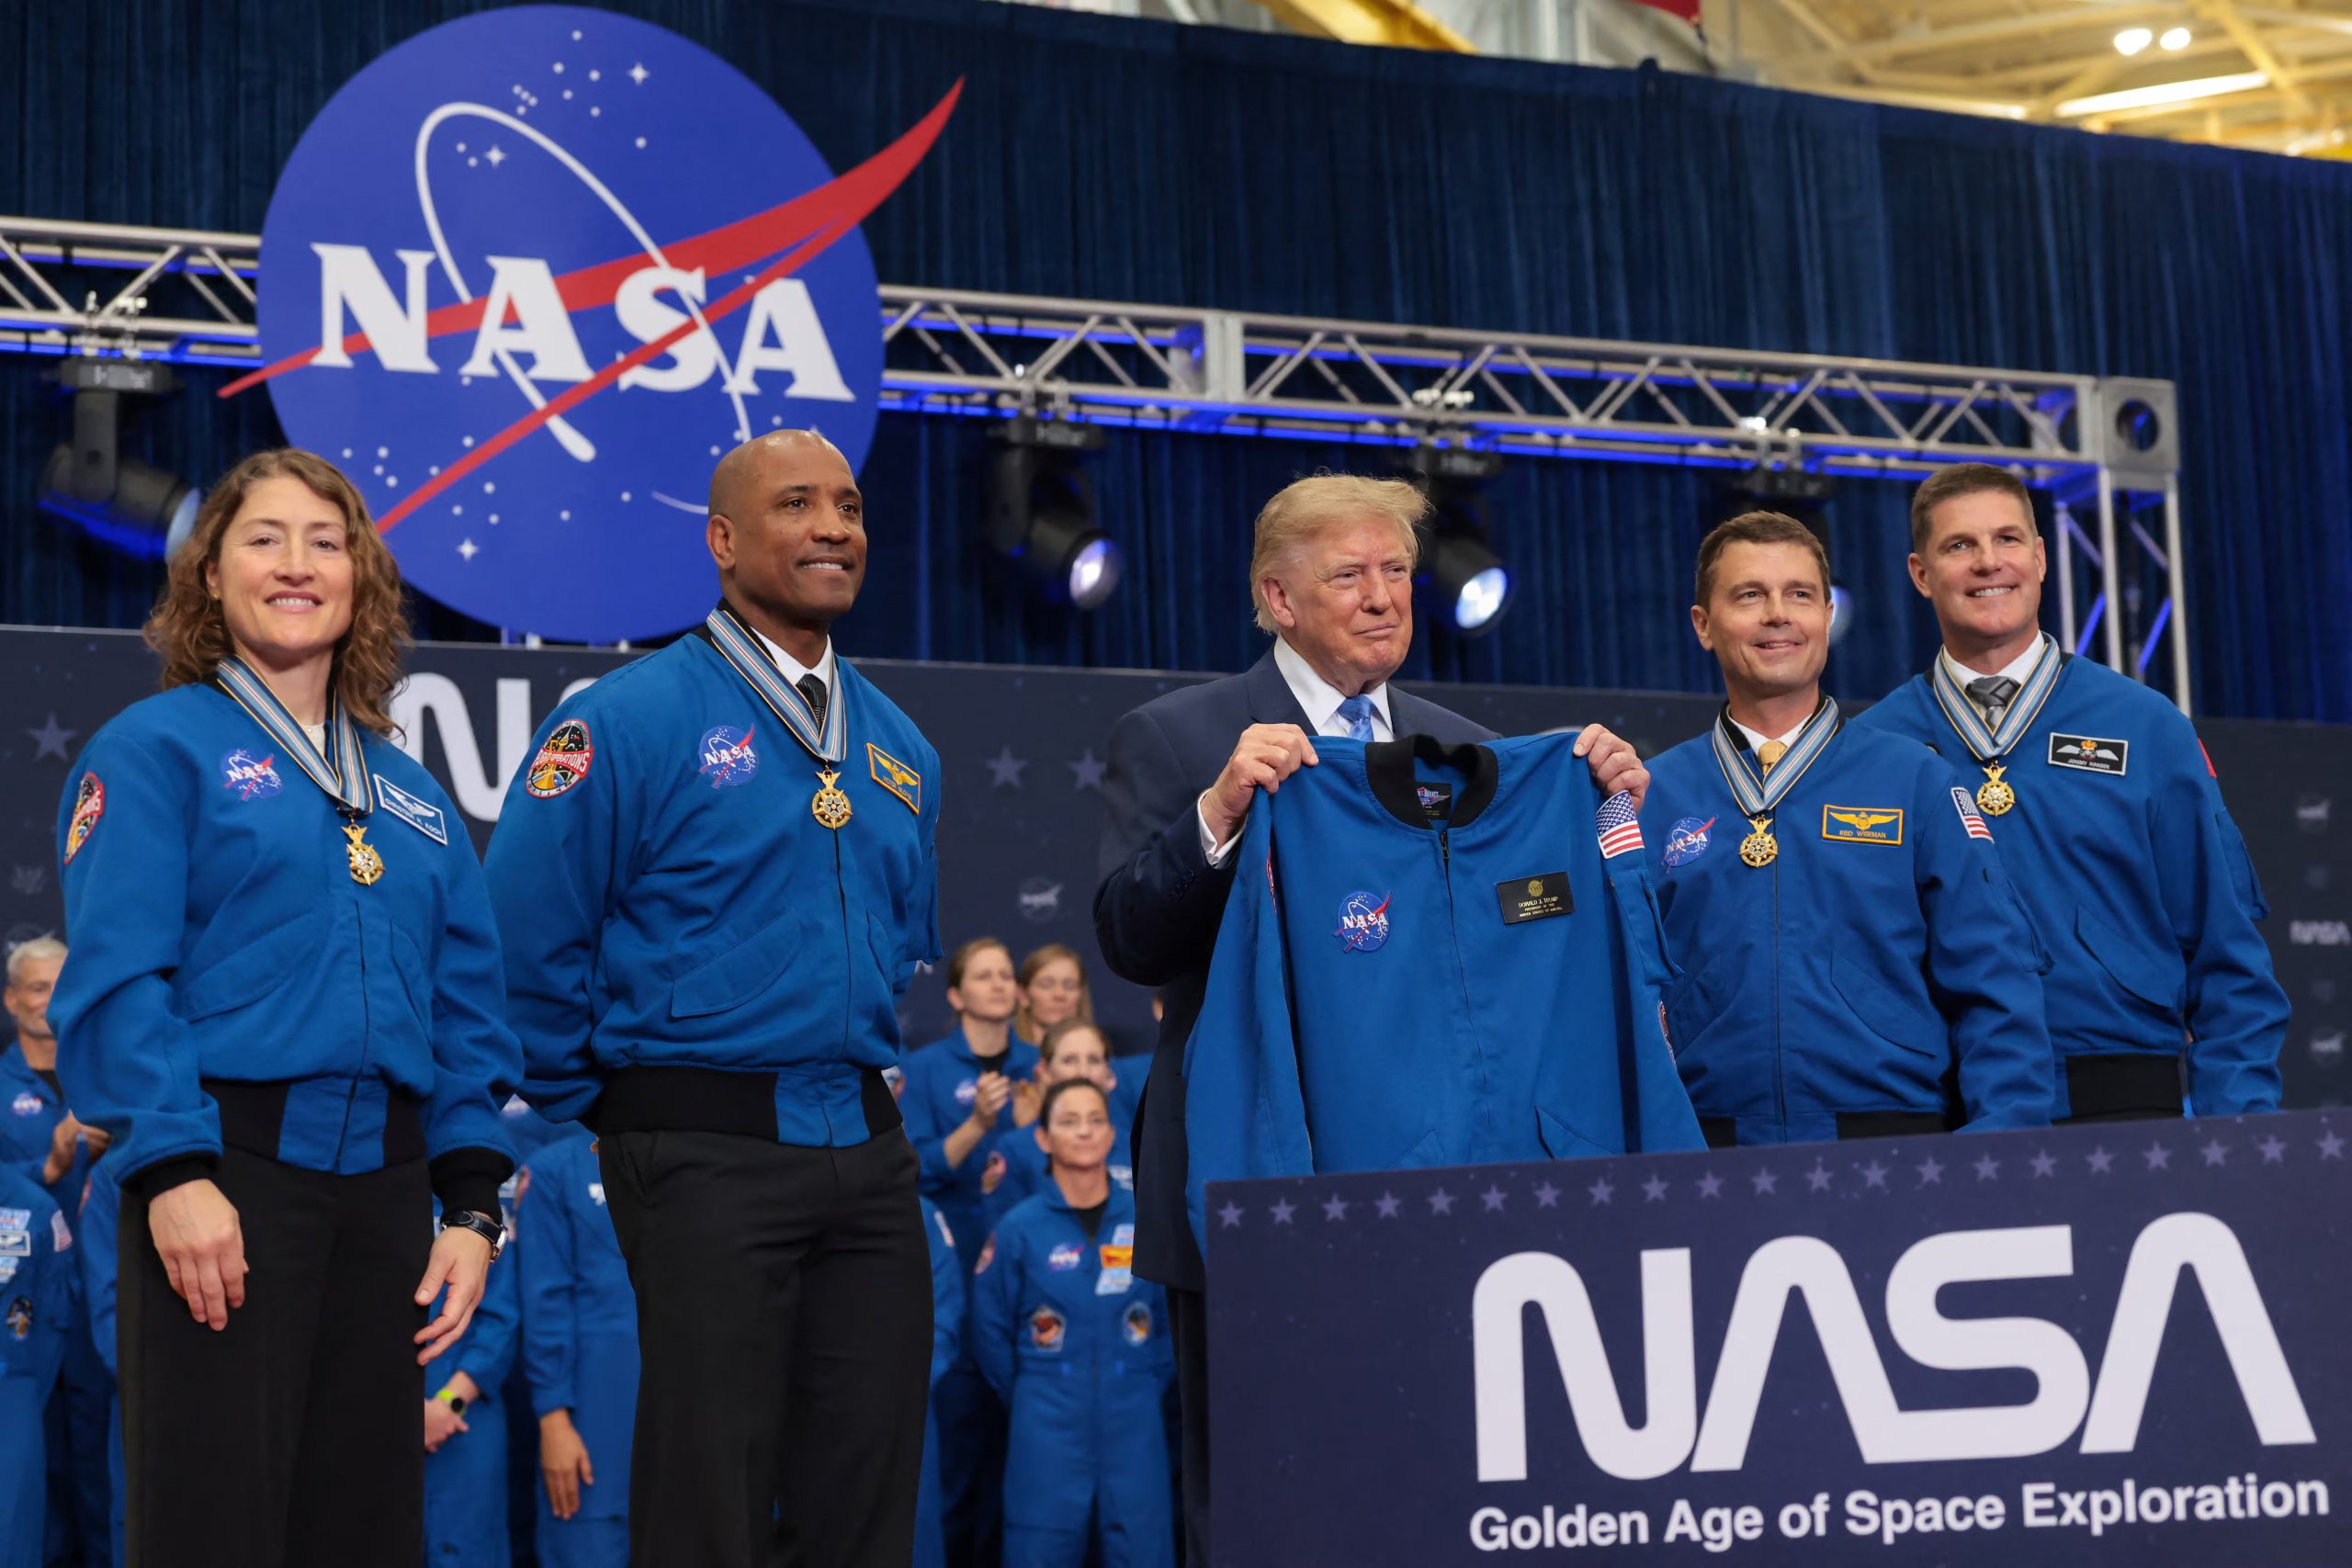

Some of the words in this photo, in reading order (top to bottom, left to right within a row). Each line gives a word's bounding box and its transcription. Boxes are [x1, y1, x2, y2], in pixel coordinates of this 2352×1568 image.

[310, 243, 857, 403] NASA
[704, 745, 756, 766] NASA
[424, 822, 443, 837] KOCH
[1857, 830, 1886, 839] WISEMAN
[1341, 912, 1389, 930] NASA
[1472, 1212, 2318, 1483] NASA
[1470, 1504, 1649, 1551] Golden
[1664, 1499, 1764, 1552] Age
[1779, 1493, 1830, 1538] of
[1845, 1490, 2006, 1545] Space
[2022, 1472, 2329, 1536] Exploration
